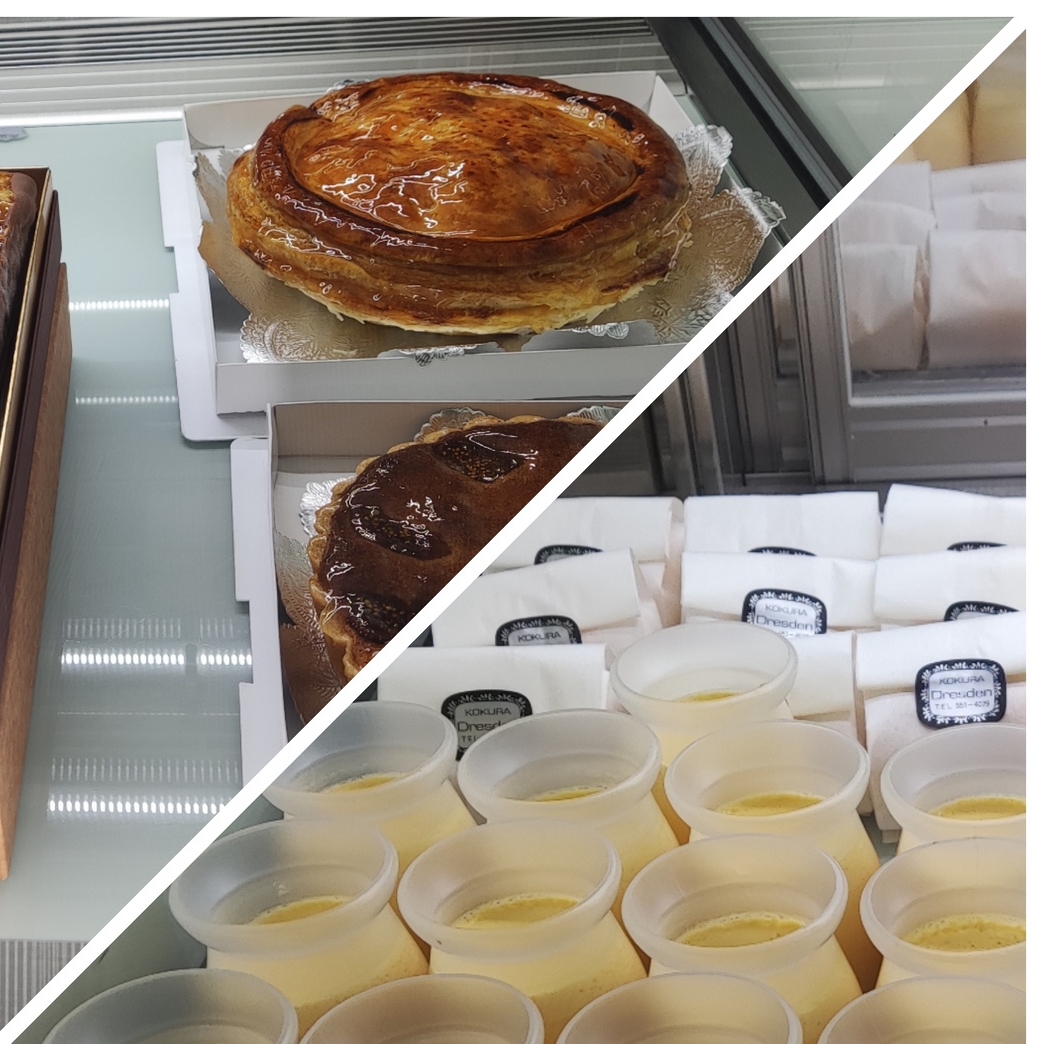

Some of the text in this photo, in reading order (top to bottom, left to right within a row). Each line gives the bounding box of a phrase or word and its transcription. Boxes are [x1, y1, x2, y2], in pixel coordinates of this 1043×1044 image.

[765, 604, 808, 616] KOKURA
[756, 615, 813, 631] Dresden
[517, 631, 562, 642] KOKURA
[939, 676, 985, 684] KOKURA
[930, 688, 993, 700] Dresden
[464, 707, 512, 717] KOKURA
